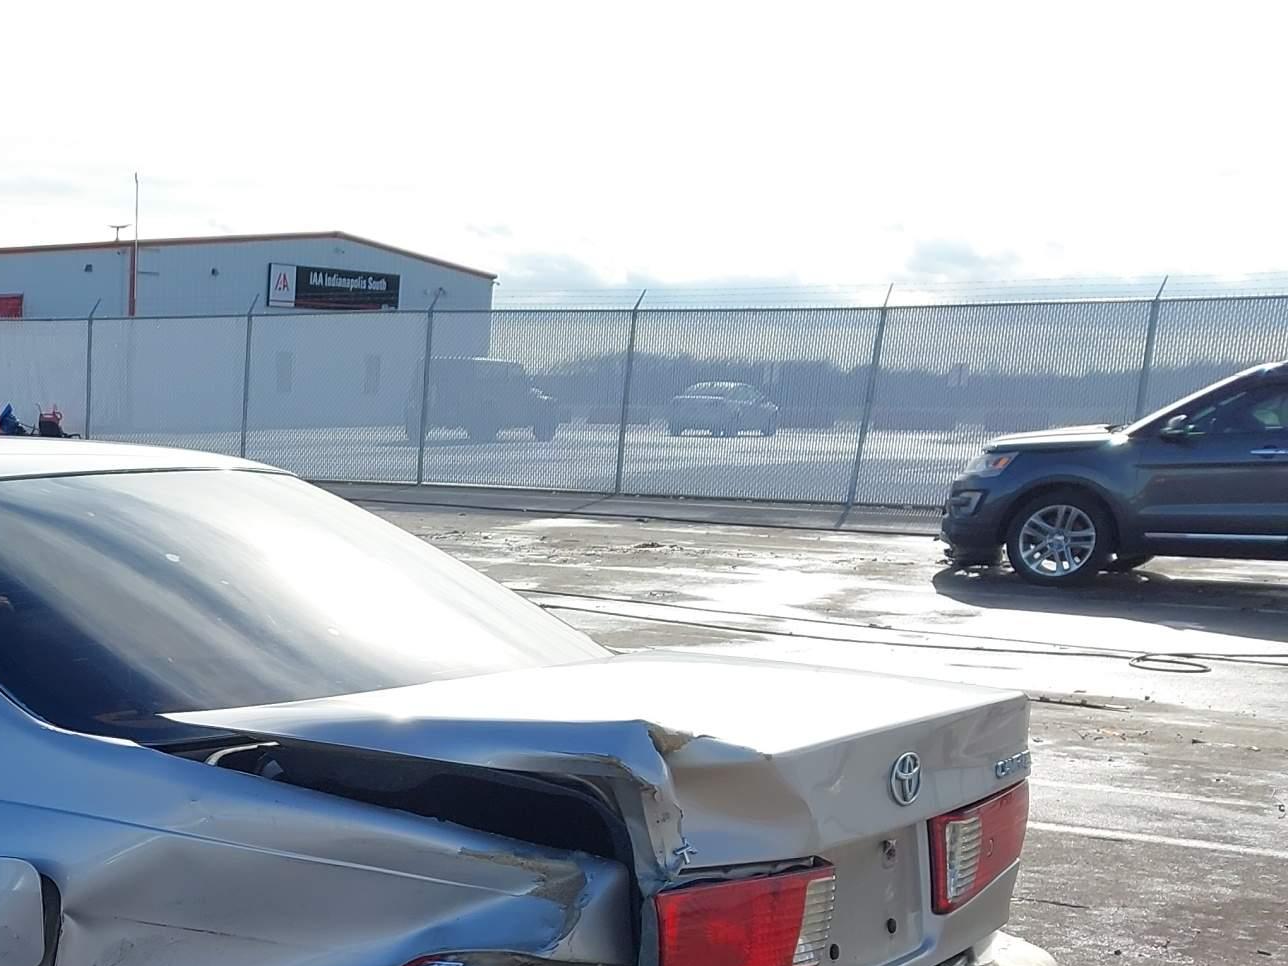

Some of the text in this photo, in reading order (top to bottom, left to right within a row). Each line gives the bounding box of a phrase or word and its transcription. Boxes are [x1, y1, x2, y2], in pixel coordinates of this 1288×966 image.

[309, 271, 388, 291] IAA Indianapolis South
